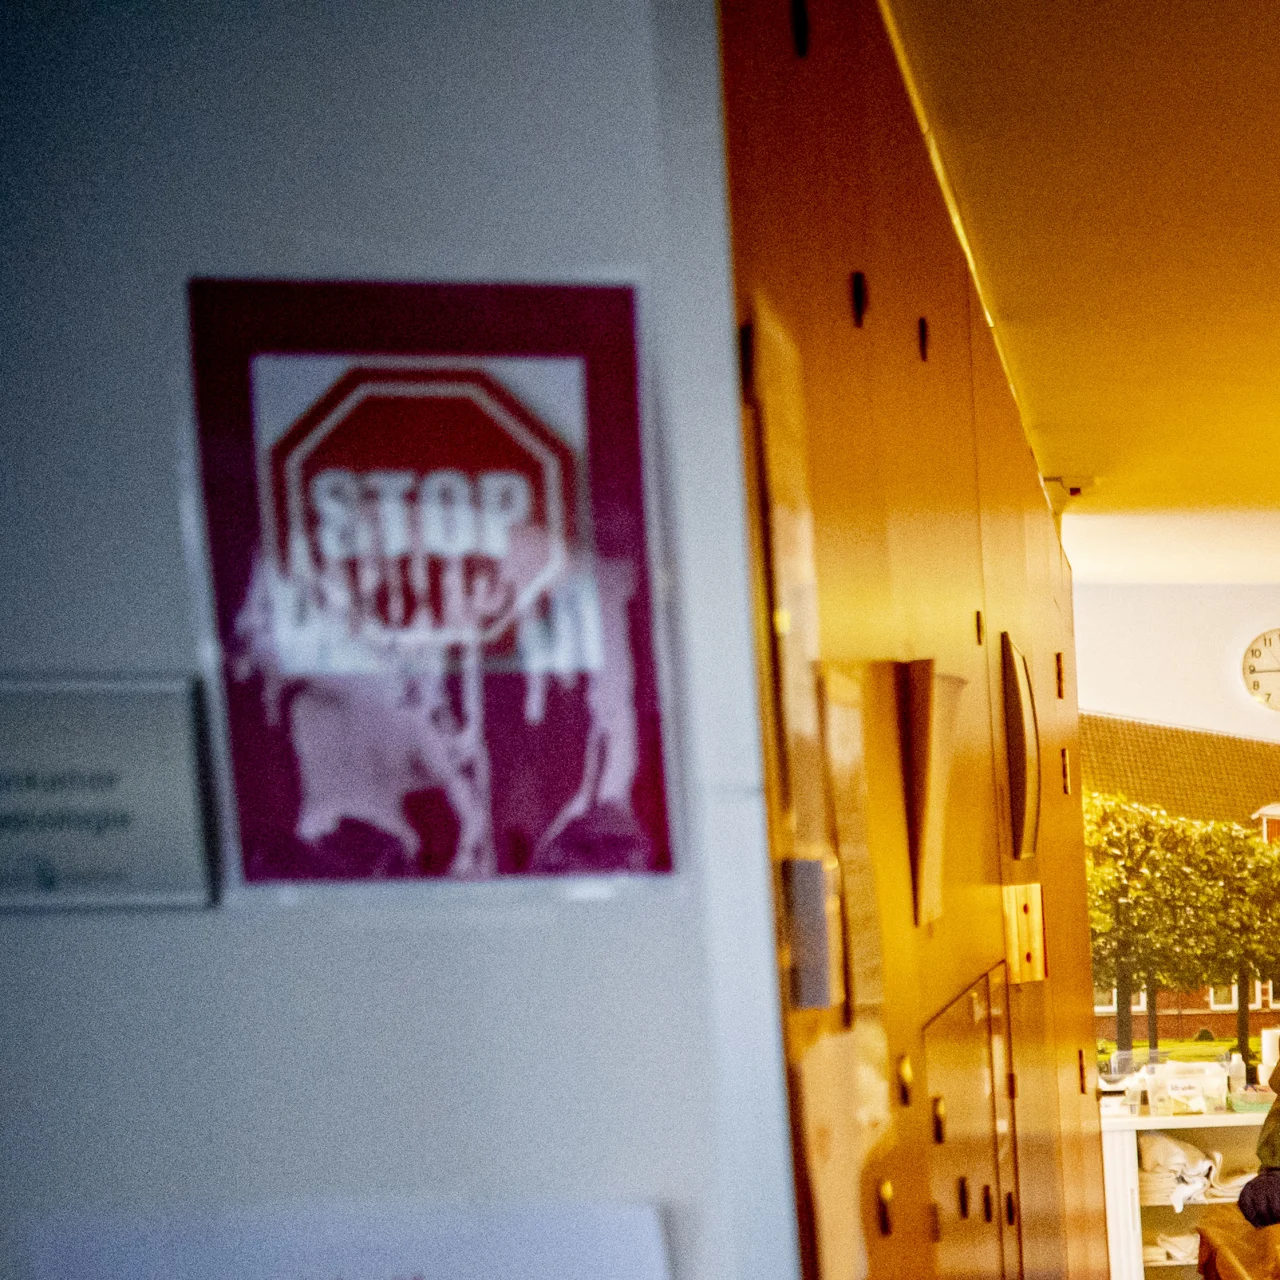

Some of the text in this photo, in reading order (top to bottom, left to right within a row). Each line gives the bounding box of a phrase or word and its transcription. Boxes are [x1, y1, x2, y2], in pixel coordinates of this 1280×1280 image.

[310, 468, 531, 559] STOP
[1263, 635, 1272, 647] 11
[1250, 648, 1262, 659] 10
[1248, 664, 1256, 675] 9
[1252, 680, 1260, 691] 8
[1265, 693, 1271, 703] 7
